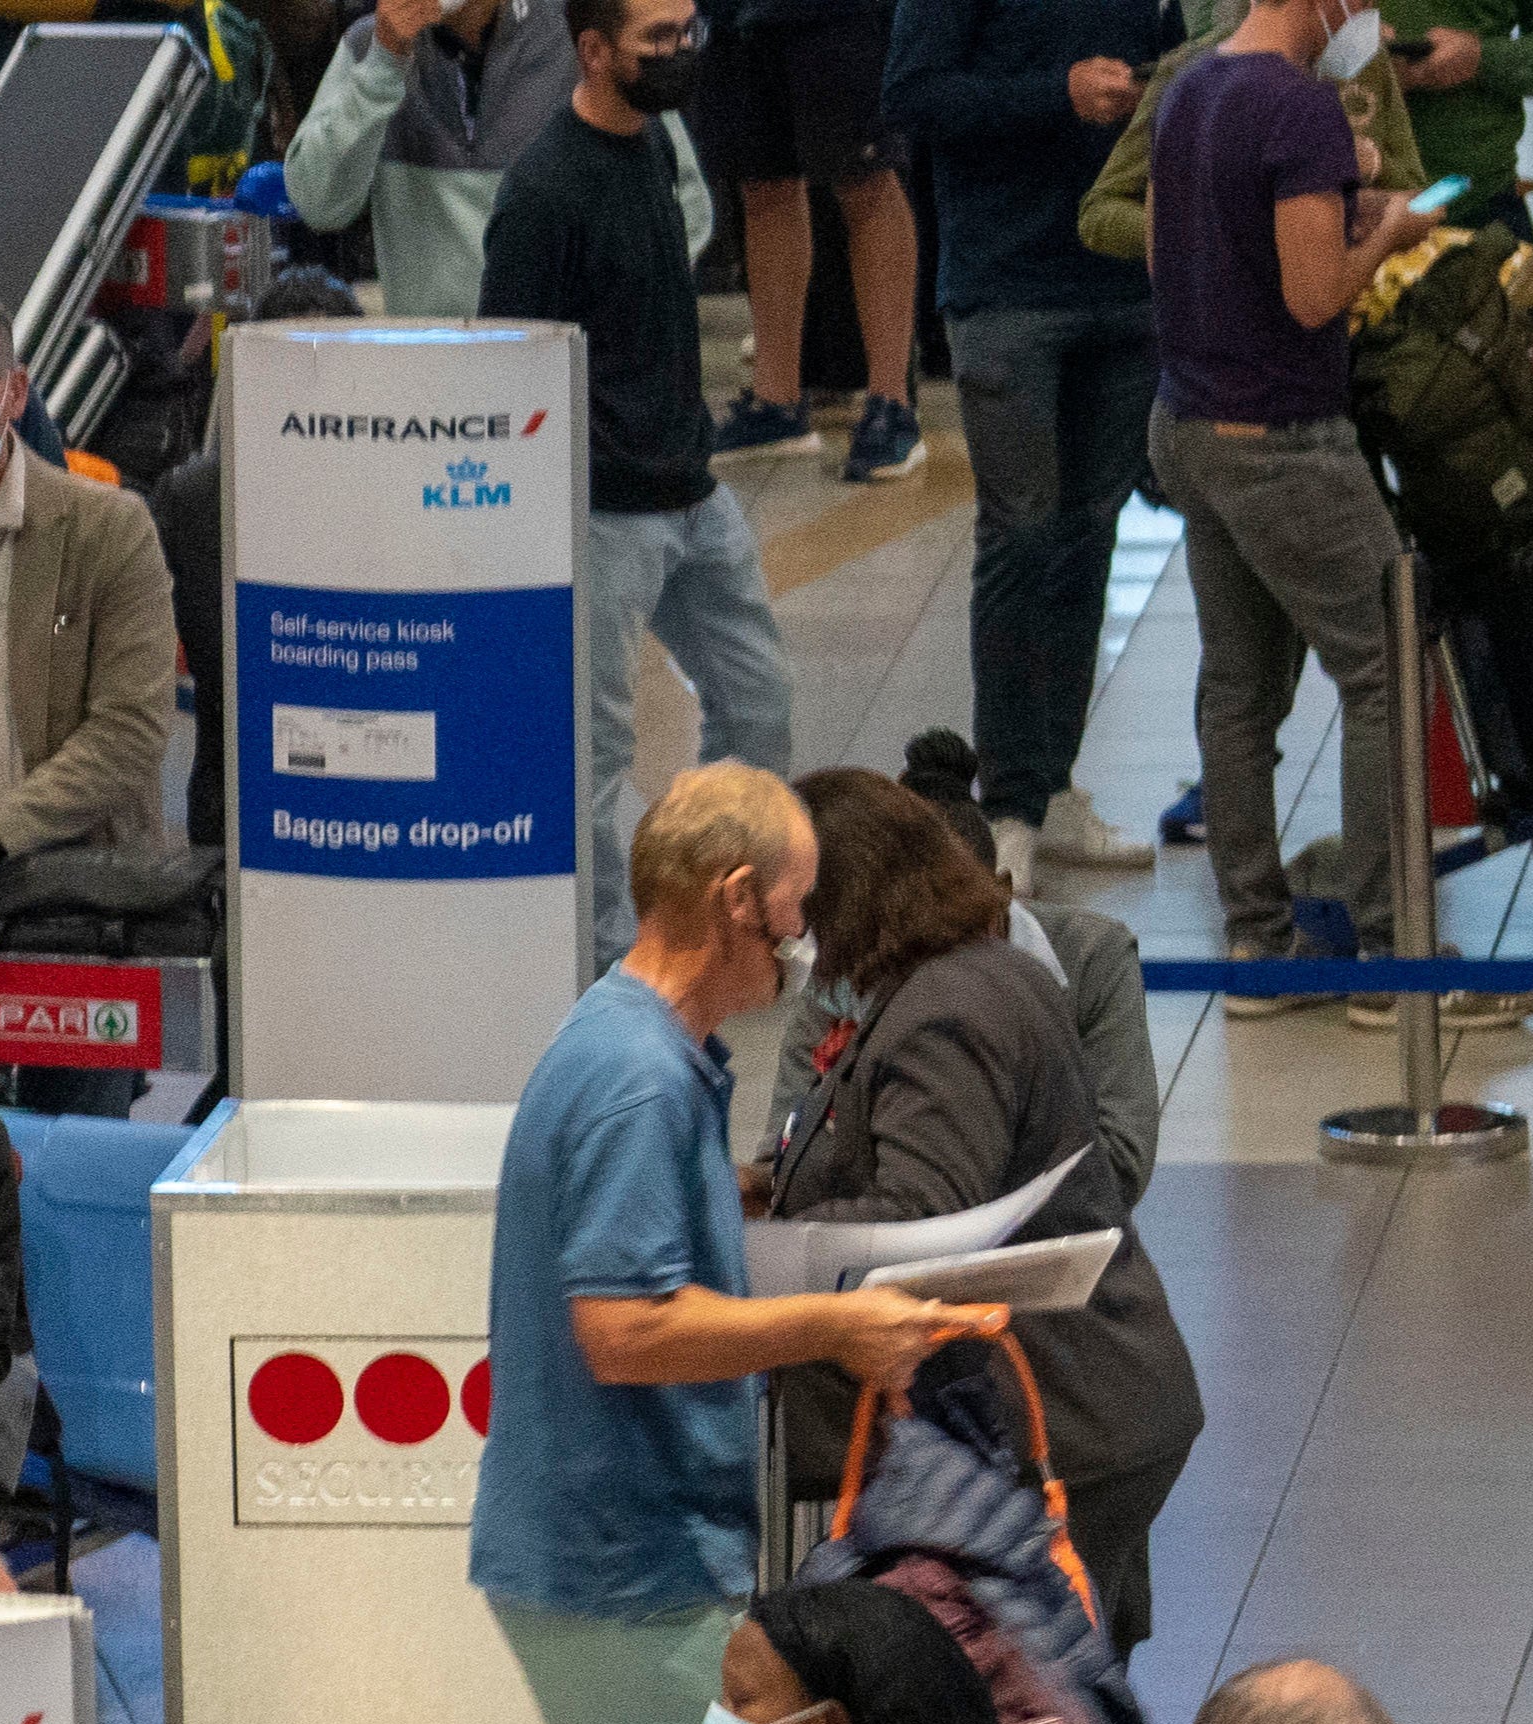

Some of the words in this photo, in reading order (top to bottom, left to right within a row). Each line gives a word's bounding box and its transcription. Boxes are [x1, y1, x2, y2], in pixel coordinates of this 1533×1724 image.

[281, 409, 511, 442] AIRFRANCE
[422, 481, 512, 508] KLM
[270, 610, 391, 643] Self-service
[397, 617, 456, 644] kiosk
[270, 638, 359, 675] boarding
[366, 648, 419, 675] pass
[272, 808, 401, 852] Baggage
[408, 812, 534, 852] drop-off
